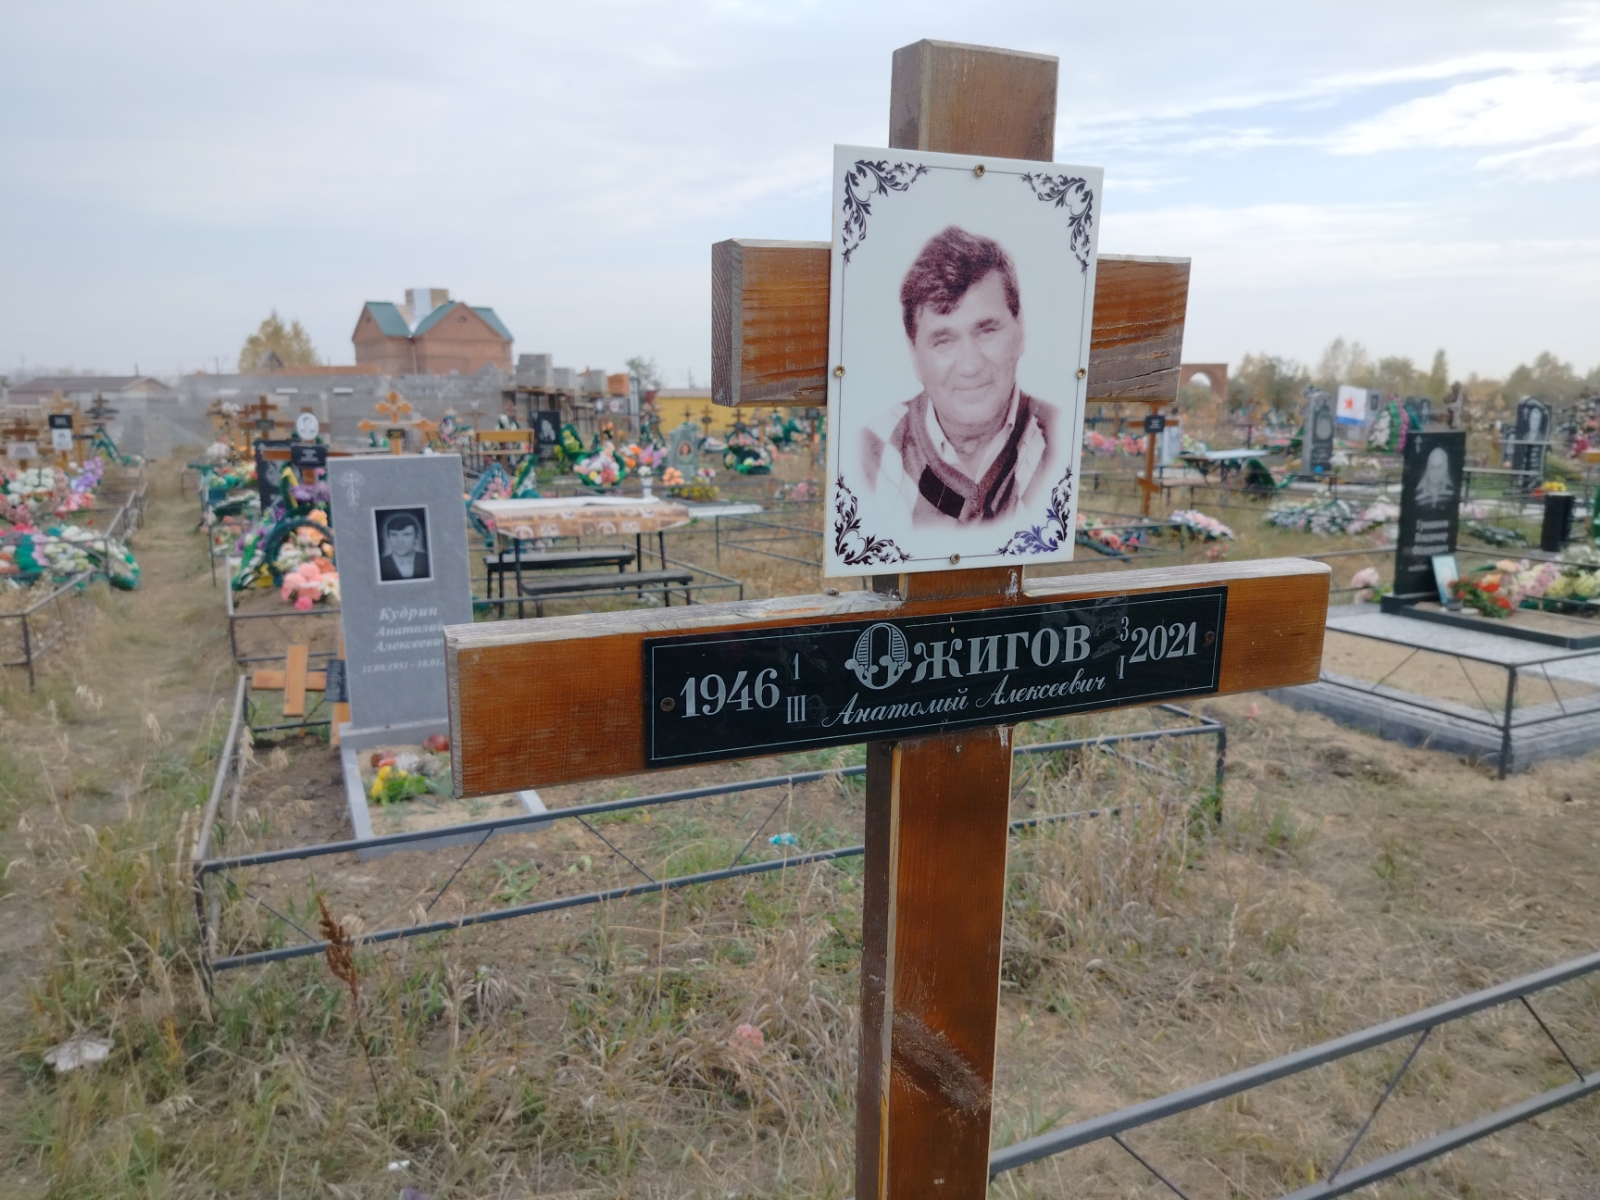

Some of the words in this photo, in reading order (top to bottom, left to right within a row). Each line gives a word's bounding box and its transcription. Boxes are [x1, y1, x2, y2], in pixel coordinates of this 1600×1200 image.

[378, 605, 438, 624] Кудрин
[1119, 616, 1130, 642] 3
[1128, 621, 1197, 664] 2021
[679, 667, 781, 719] 1946
[785, 694, 808, 724] III
[821, 687, 970, 728] Анатолий
[975, 667, 1106, 709] Алексеевич
